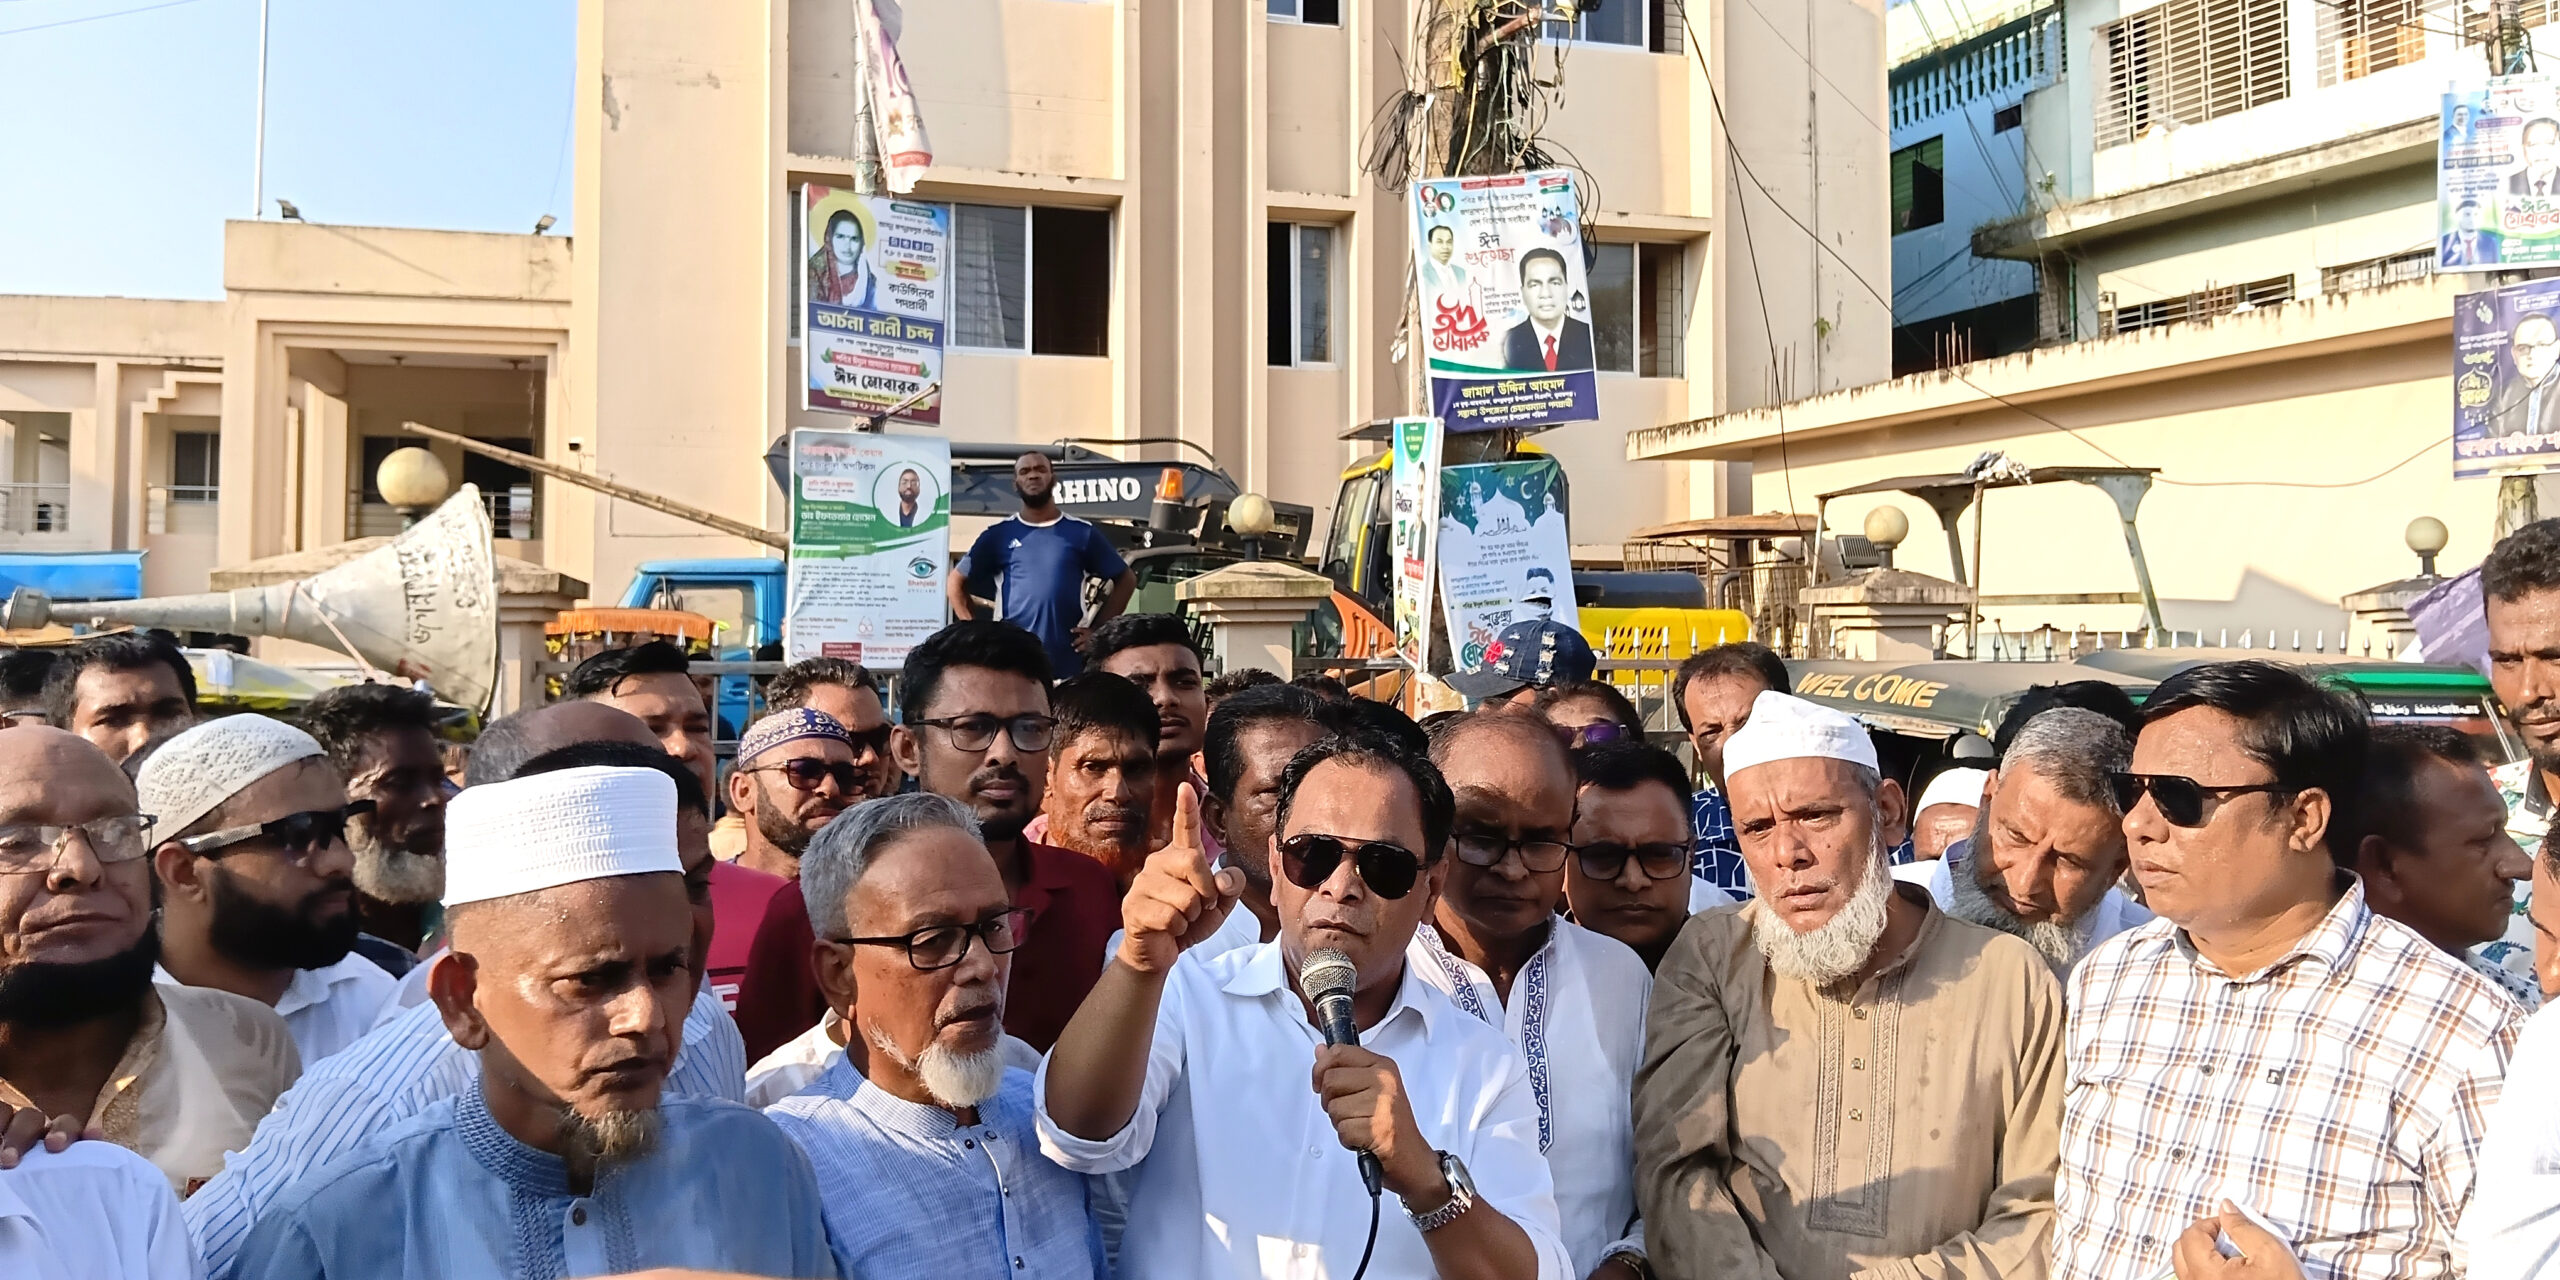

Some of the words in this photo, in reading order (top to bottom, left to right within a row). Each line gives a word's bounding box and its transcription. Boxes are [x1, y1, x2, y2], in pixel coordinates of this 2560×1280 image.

[1478, 232, 1501, 248] ঈদ
[888, 283, 934, 299] কাউন্সিলর
[817, 310, 864, 332] অর্চনা
[869, 316, 902, 338] রানী
[906, 324, 935, 343] চন্দ
[834, 364, 857, 386] ঈদ
[862, 375, 920, 395] মোবারক
[1461, 385, 1495, 399] জামাল
[1498, 381, 1527, 396] উদ্দিন
[1529, 378, 1566, 393] আহমদ
[1051, 477, 1141, 504] RHINO
[1796, 671, 1949, 708] WELCOME
